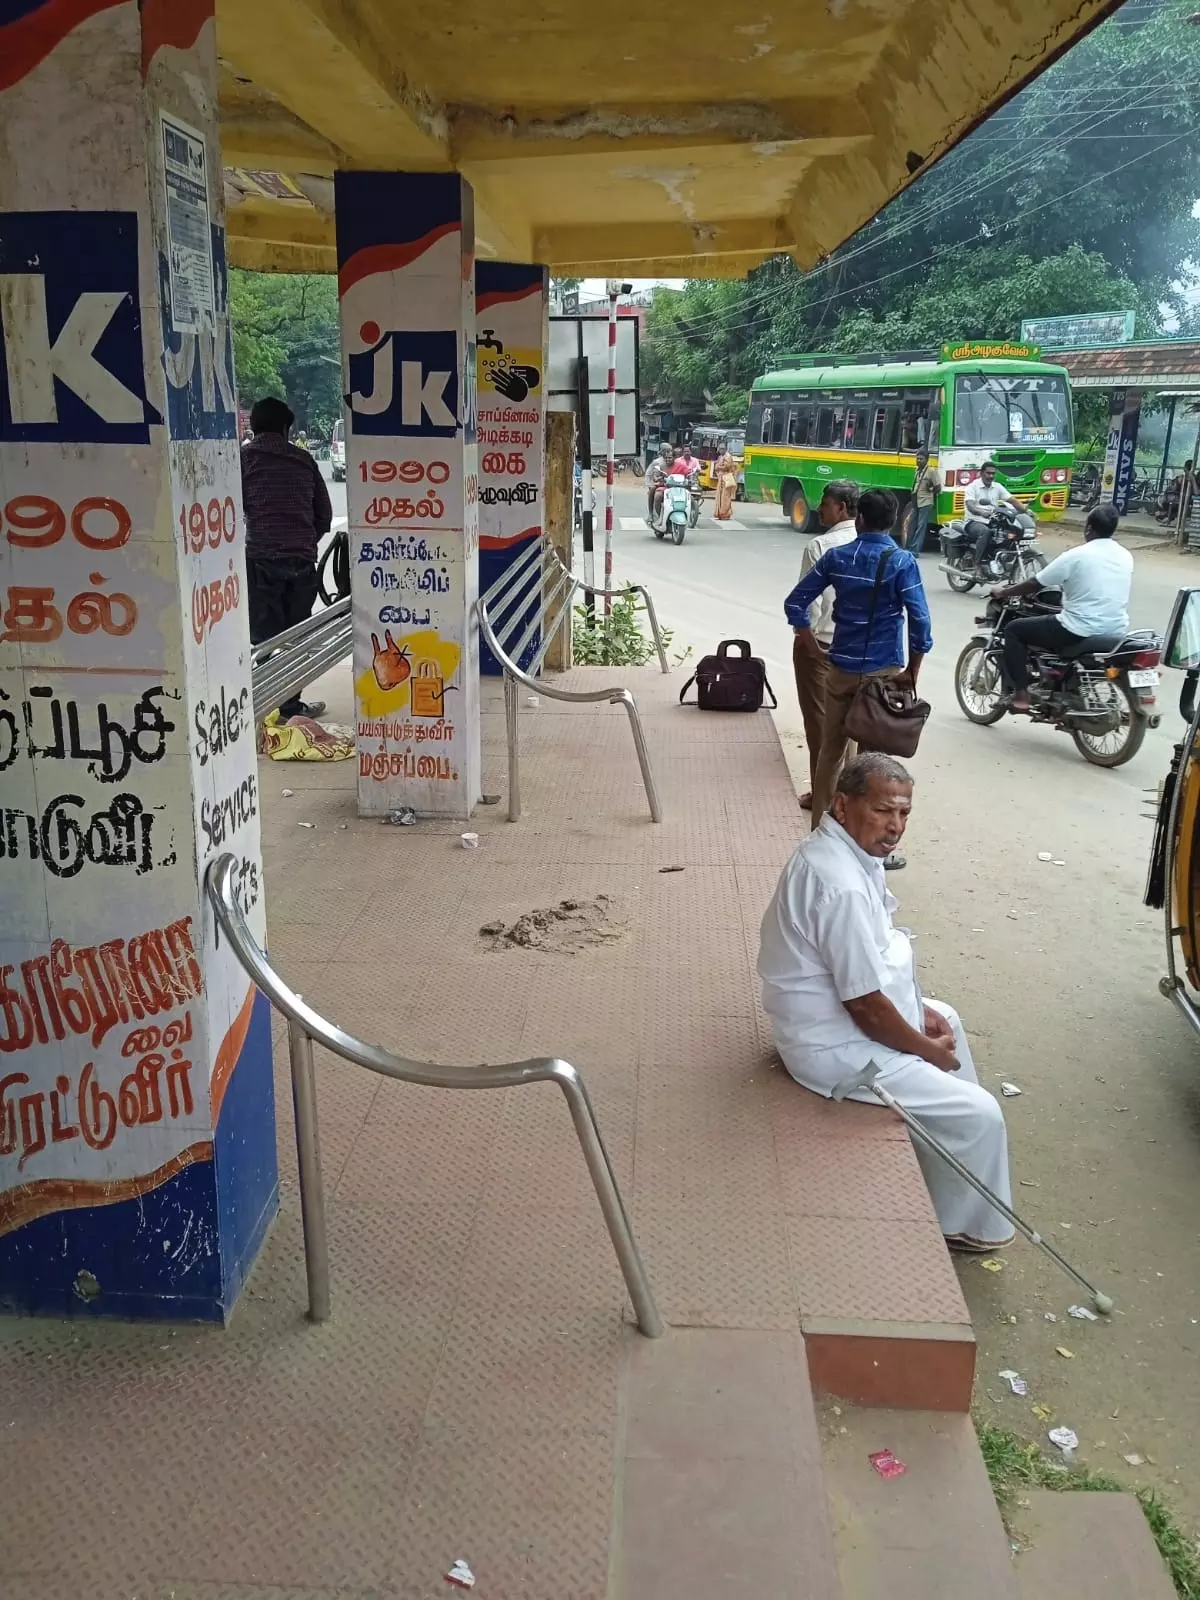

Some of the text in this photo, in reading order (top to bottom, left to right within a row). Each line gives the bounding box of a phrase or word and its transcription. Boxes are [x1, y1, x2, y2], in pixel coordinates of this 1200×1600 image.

[977, 379, 1044, 392] AVT
[359, 460, 450, 484] 1990
[482, 452, 527, 475] கை
[365, 489, 444, 524] முதல்
[180, 496, 236, 554] 1990
[0, 572, 139, 643] தல்
[191, 558, 240, 645] முதல்
